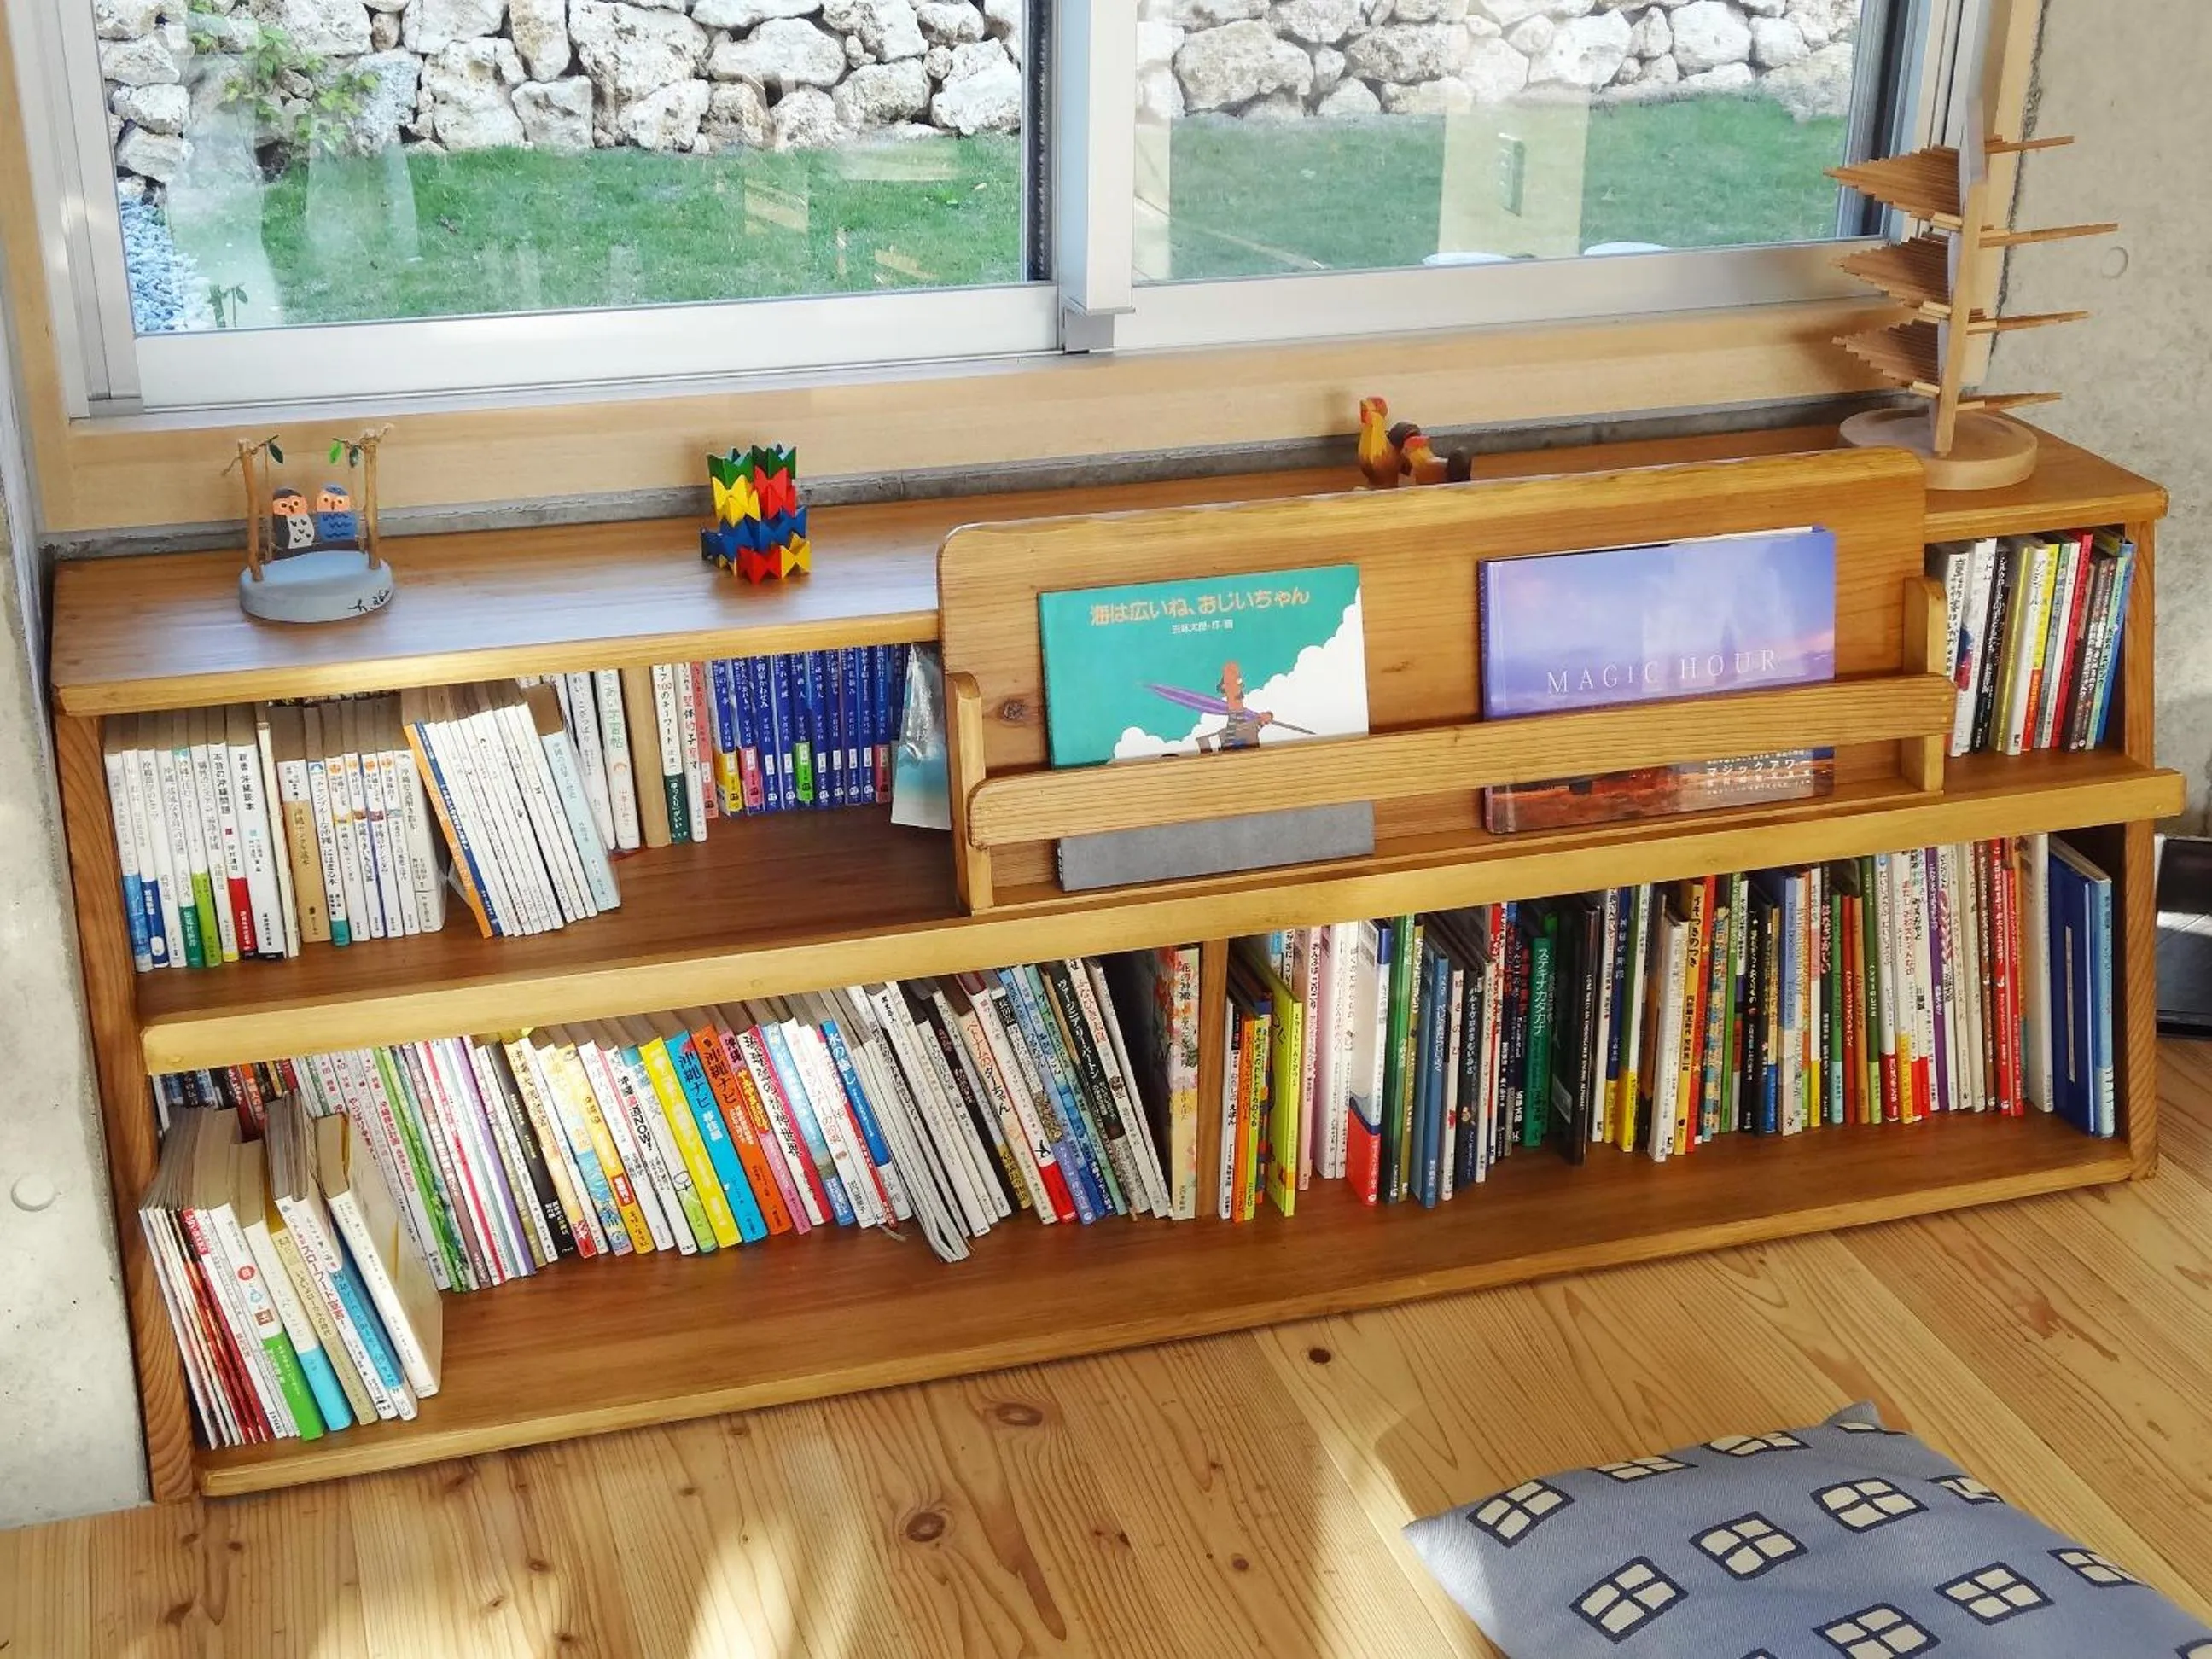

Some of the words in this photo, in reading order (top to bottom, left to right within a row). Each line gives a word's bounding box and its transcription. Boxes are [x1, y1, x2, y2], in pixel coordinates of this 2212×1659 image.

[1089, 589, 1310, 626] 海は広いね、おじいちゃん
[1546, 660, 1661, 696] MAGIC
[1679, 648, 1778, 679] HOUR
[1707, 759, 1811, 776] マジックアワー
[678, 1051, 711, 1109] 沖縄ナビ
[704, 1049, 737, 1104] 沖縄ナビ
[966, 1023, 1010, 1114] ベトナムのダーちゃん
